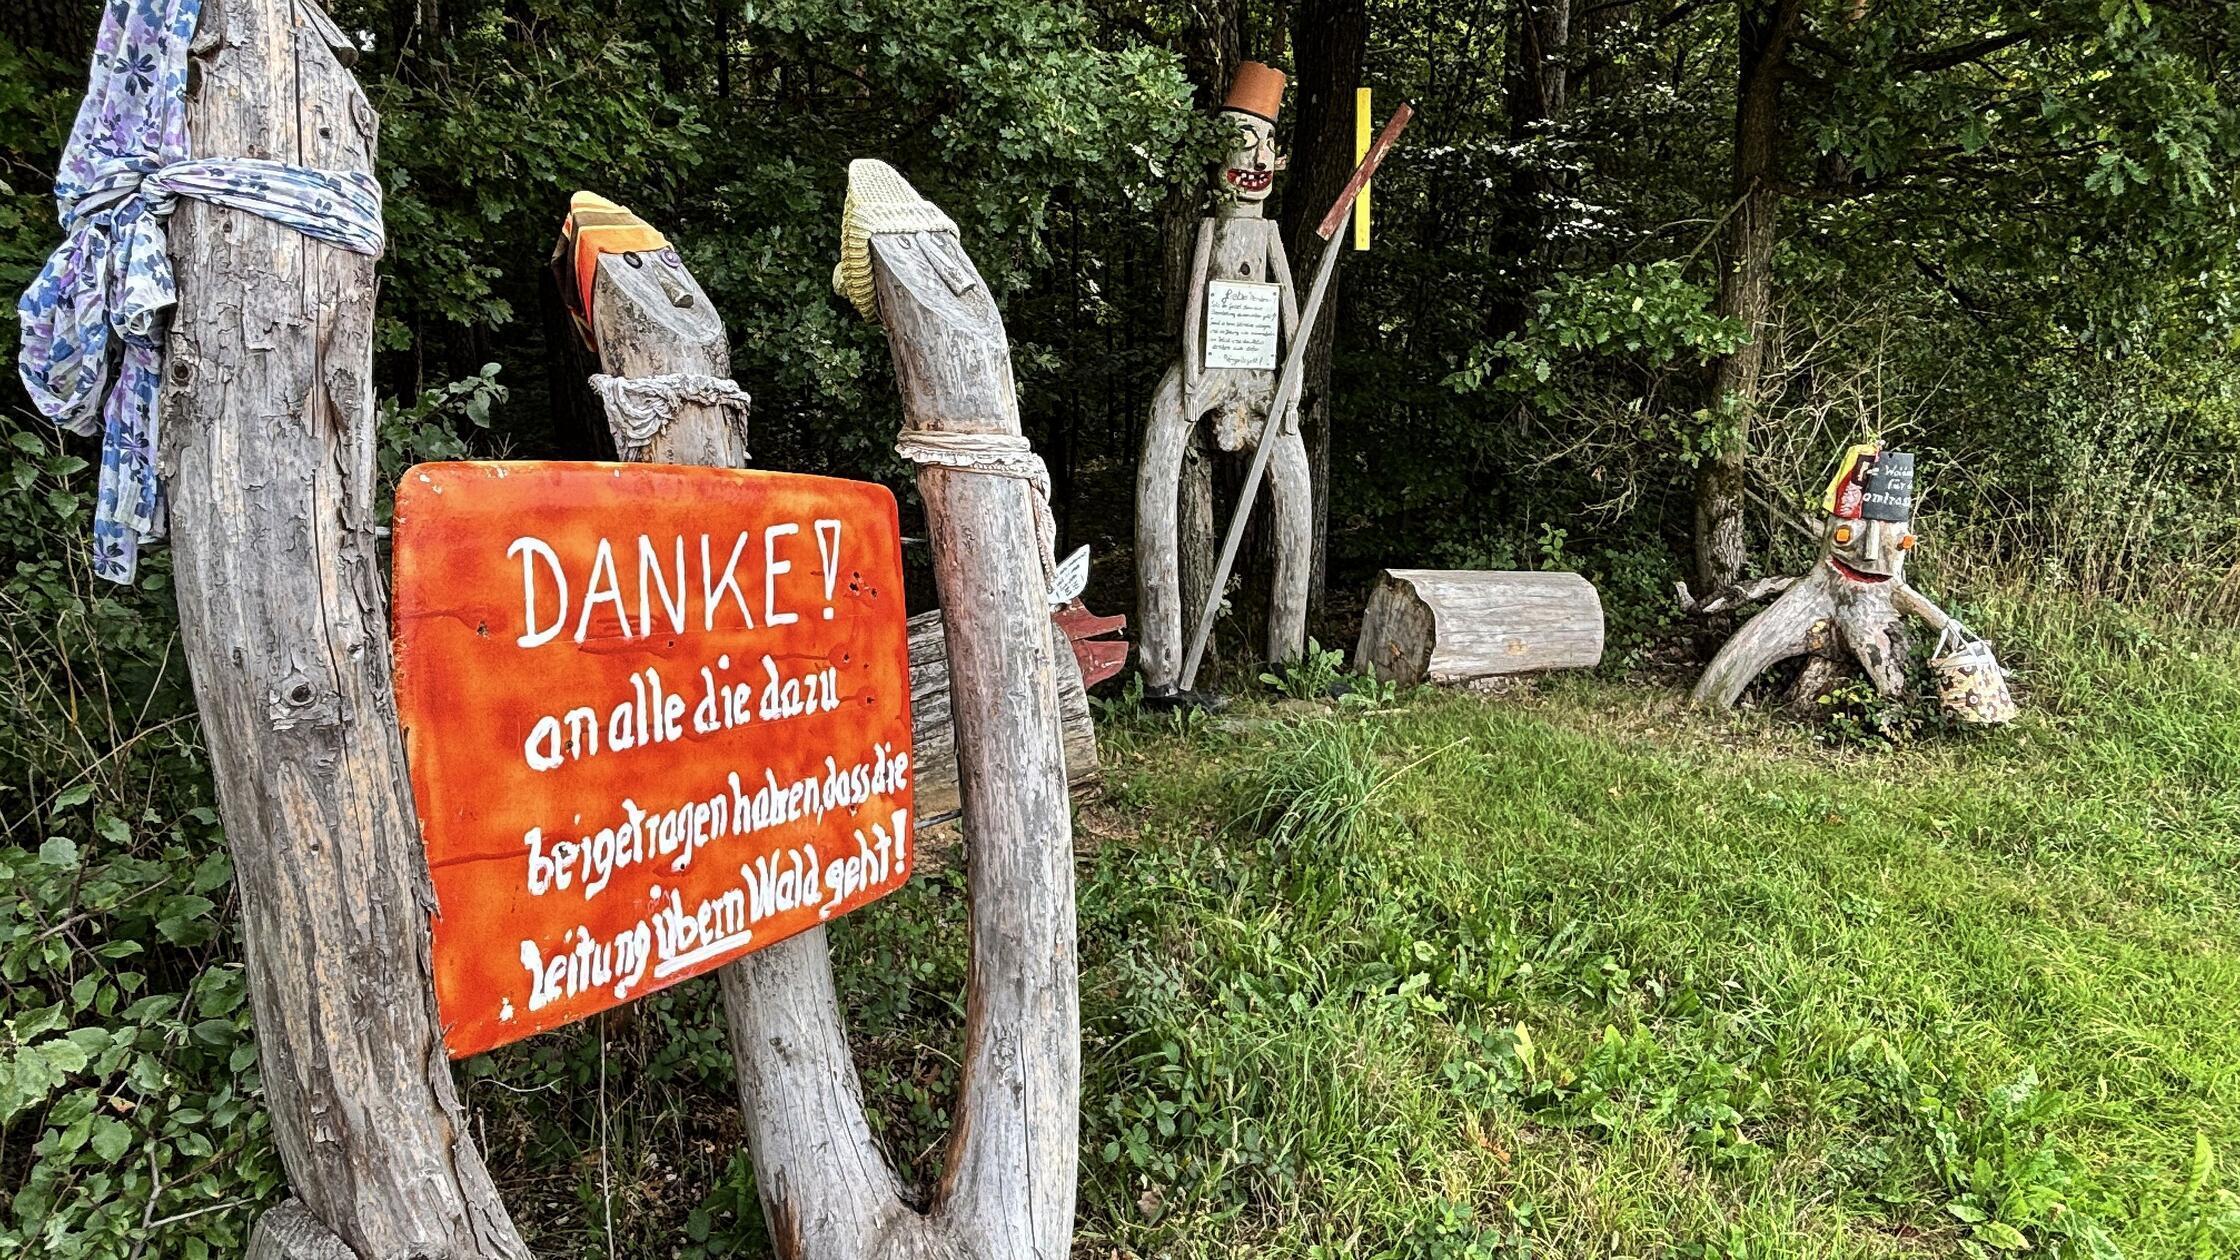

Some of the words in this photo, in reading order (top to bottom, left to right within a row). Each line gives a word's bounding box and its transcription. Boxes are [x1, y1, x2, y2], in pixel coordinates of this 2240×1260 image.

[506, 519, 841, 648] DANKE!
[524, 706, 598, 771] an
[608, 667, 686, 752] alle
[693, 654, 752, 734] die
[759, 654, 841, 722] dazu
[524, 793, 727, 901] beigetragen
[872, 742, 909, 795] die
[740, 844, 822, 924] Wald
